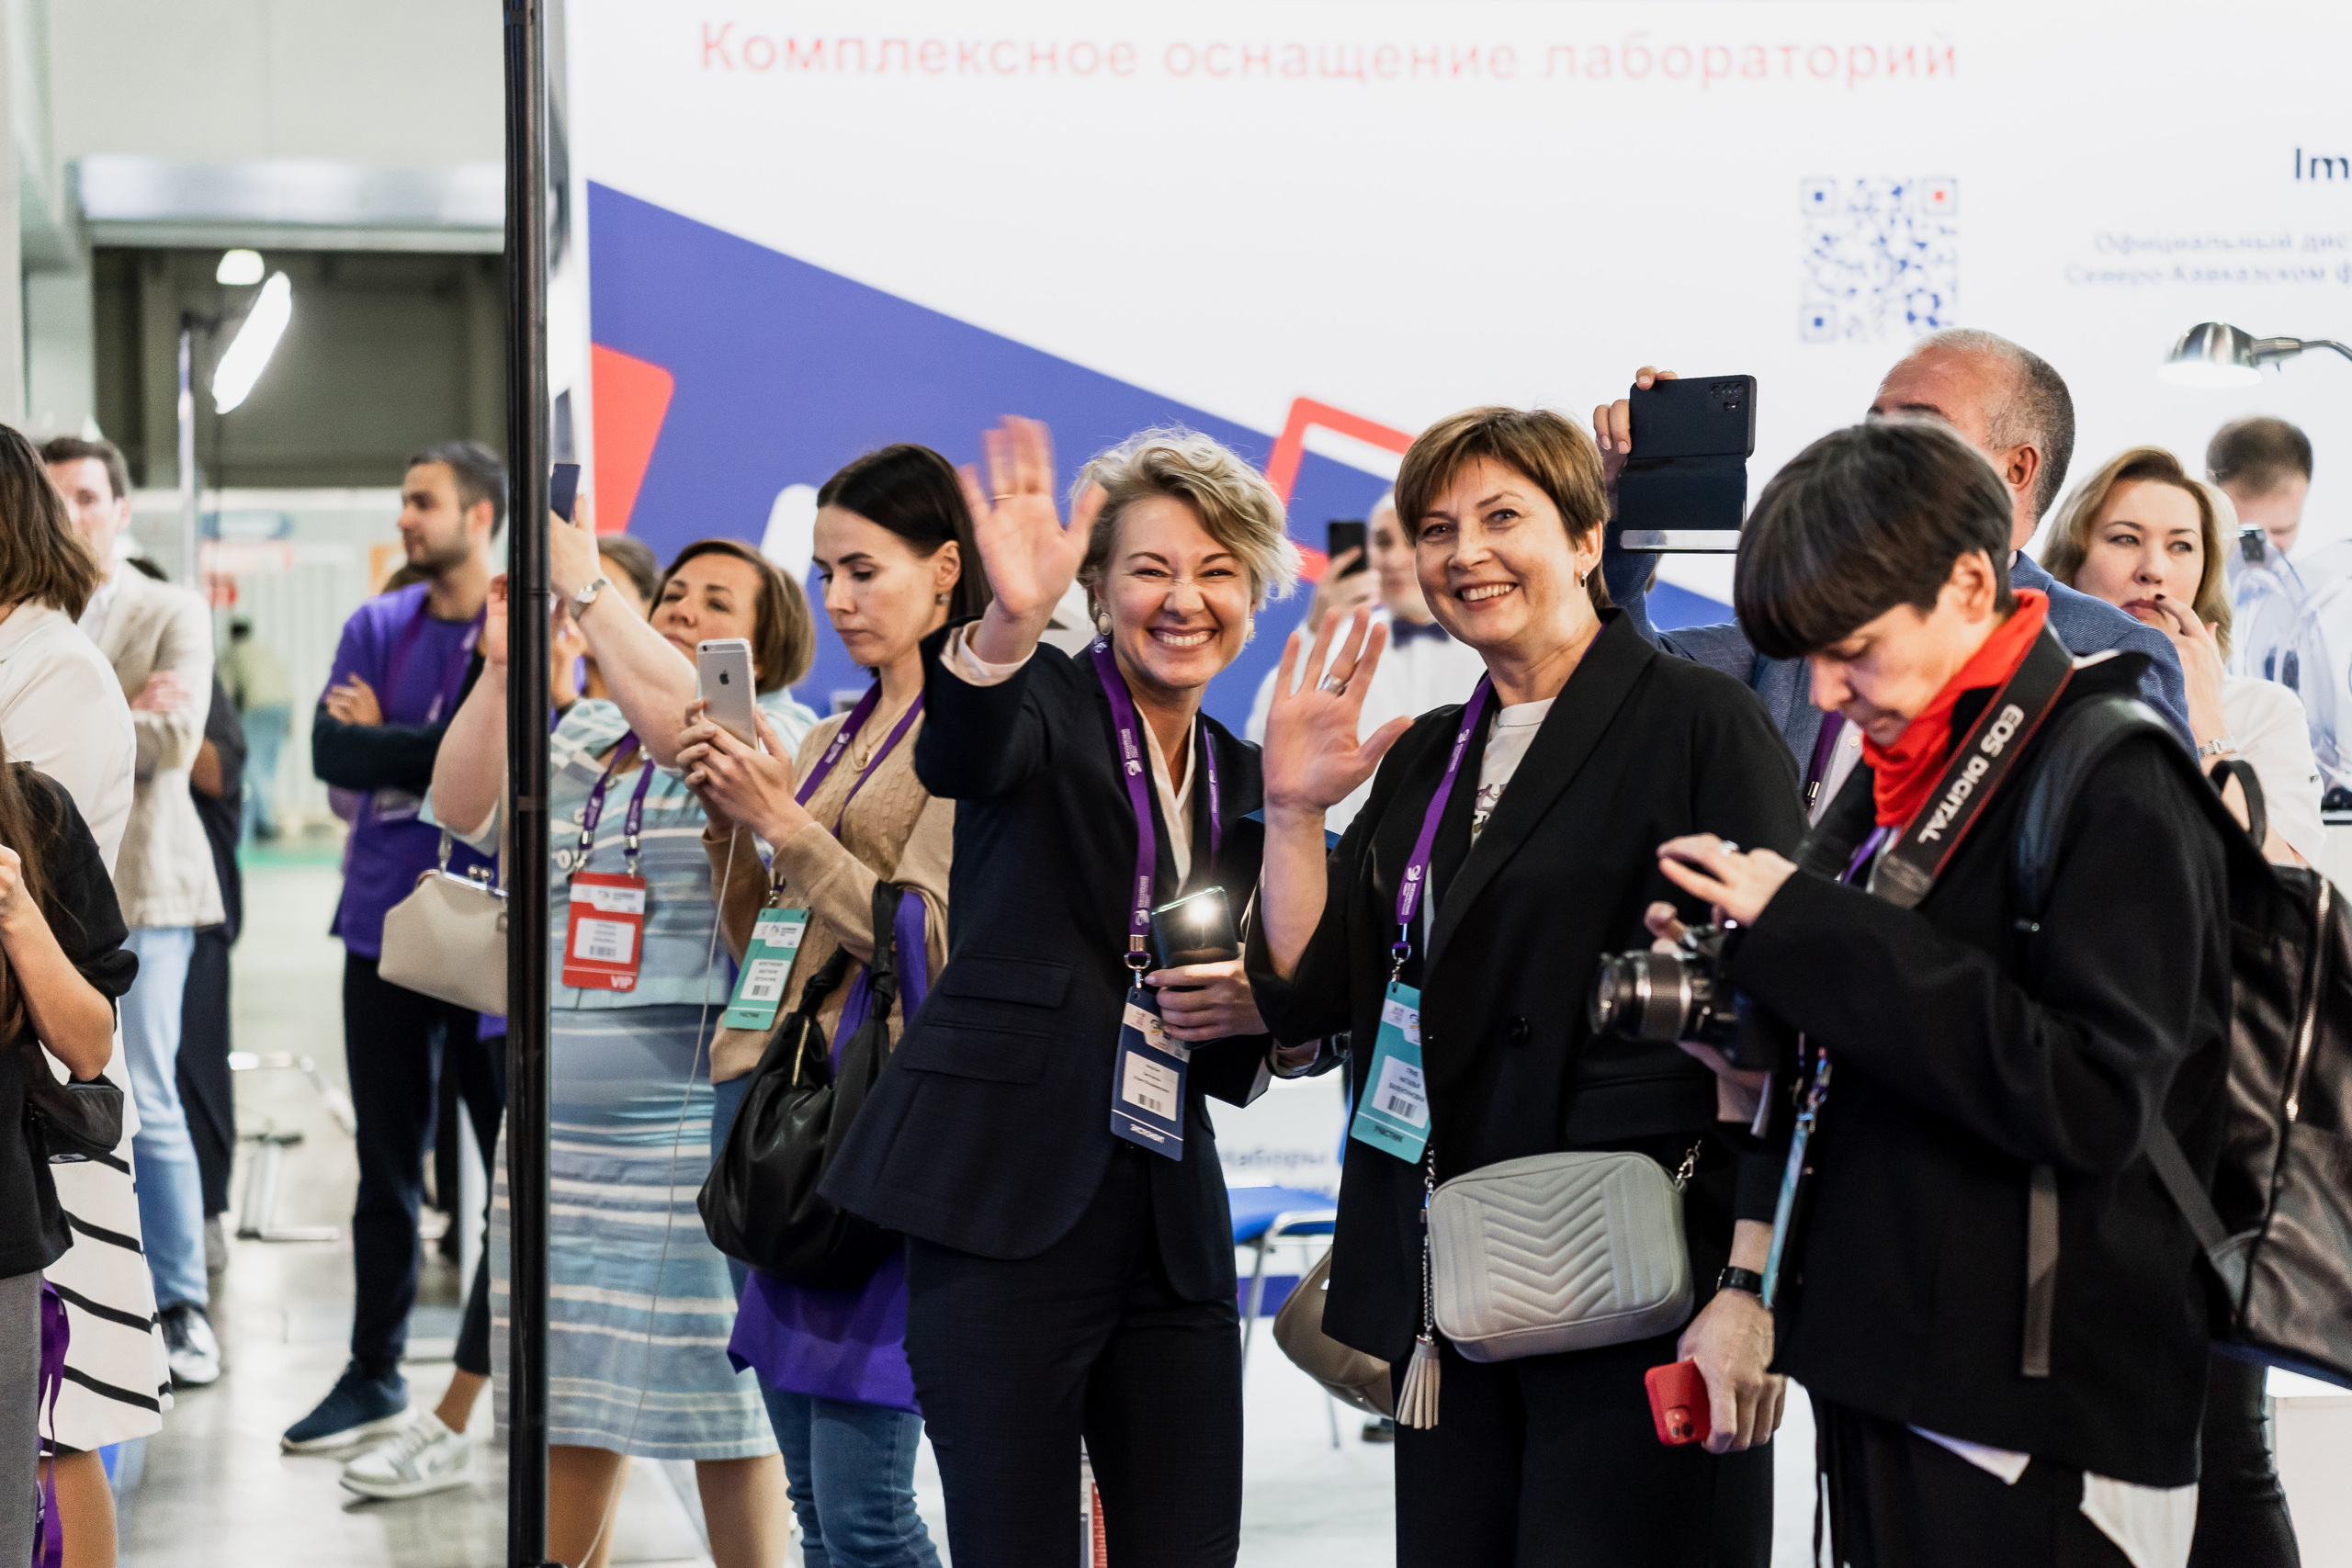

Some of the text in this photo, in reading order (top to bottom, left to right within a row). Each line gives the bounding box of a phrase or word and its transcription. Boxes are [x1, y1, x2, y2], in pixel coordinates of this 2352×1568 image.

[702, 20, 1958, 90] Комплексное оснащение лабораторий
[1917, 704, 2025, 843] EOS DIGITAL
[610, 975, 634, 990] VIP
